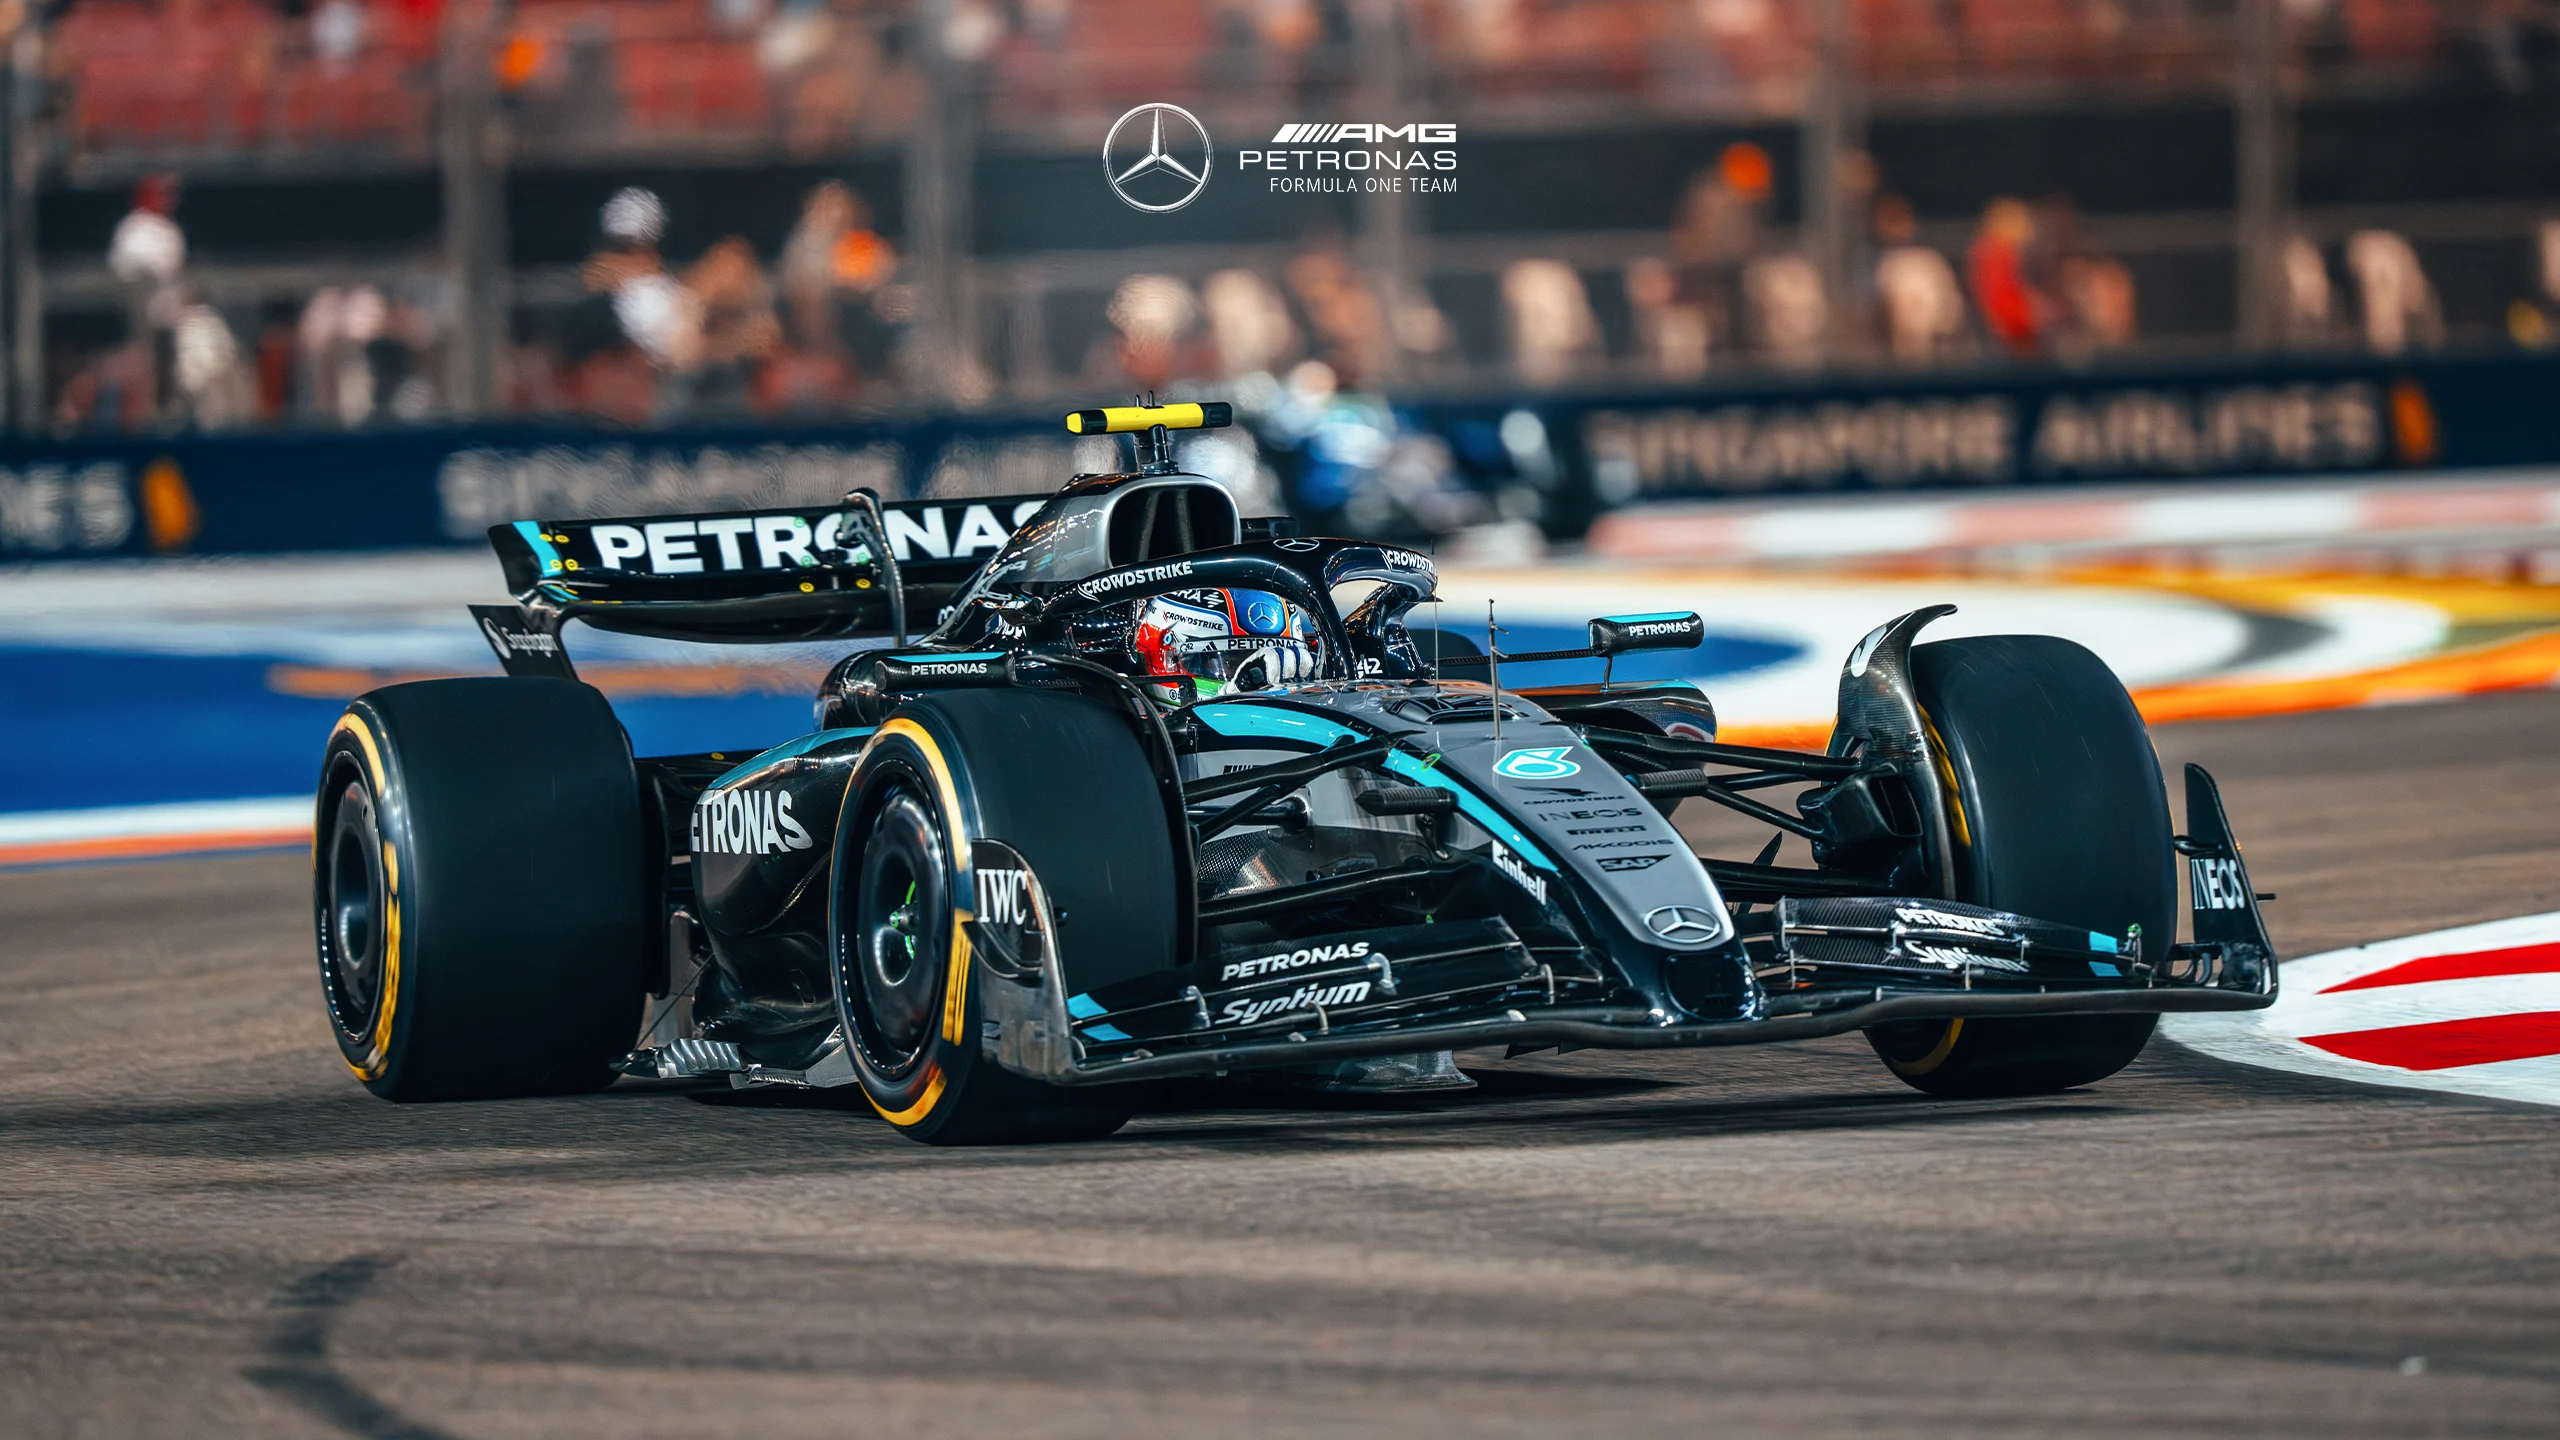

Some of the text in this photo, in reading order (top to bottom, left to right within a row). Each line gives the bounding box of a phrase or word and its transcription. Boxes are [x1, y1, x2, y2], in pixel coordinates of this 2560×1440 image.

[1082, 560, 1194, 596] CROWDSTRIKE
[1165, 611, 1224, 631] CROWDSTRIKE
[1628, 621, 1691, 637] PETRONAS
[911, 663, 988, 677] PETRONAS
[690, 788, 813, 855] ETRONAS
[1538, 807, 1643, 822] INEOS
[1492, 839, 1547, 905] Einhell
[1599, 856, 1660, 871] SAP
[975, 868, 1028, 926] IWC
[2190, 858, 2246, 910] INEOS
[1221, 941, 1371, 982] PETRONAS
[1214, 981, 1372, 1025] Syntium
